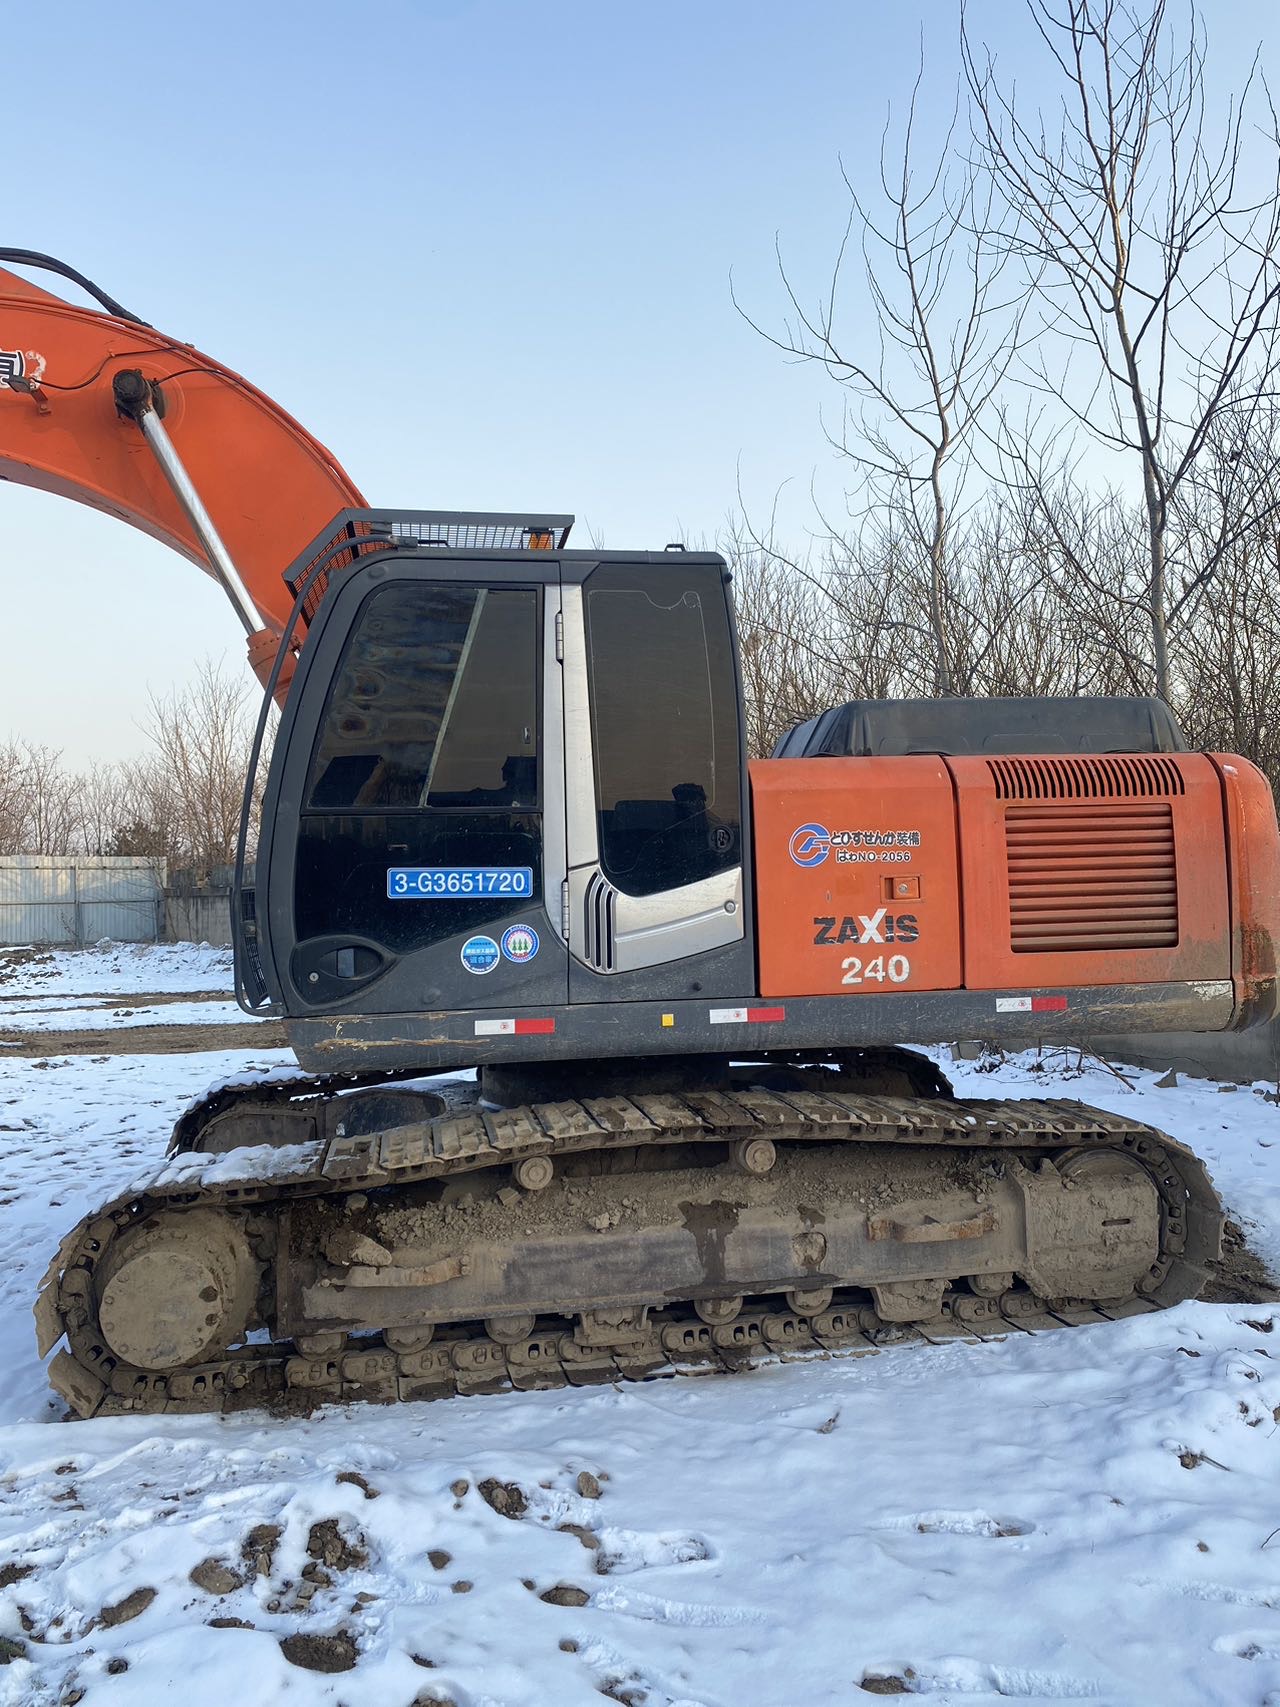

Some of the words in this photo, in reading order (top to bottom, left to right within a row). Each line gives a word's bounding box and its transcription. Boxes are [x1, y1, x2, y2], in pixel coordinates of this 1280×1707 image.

[394, 872, 525, 893] 3-G3651720
[813, 908, 919, 945] ZAXIS
[841, 954, 910, 985] 240
